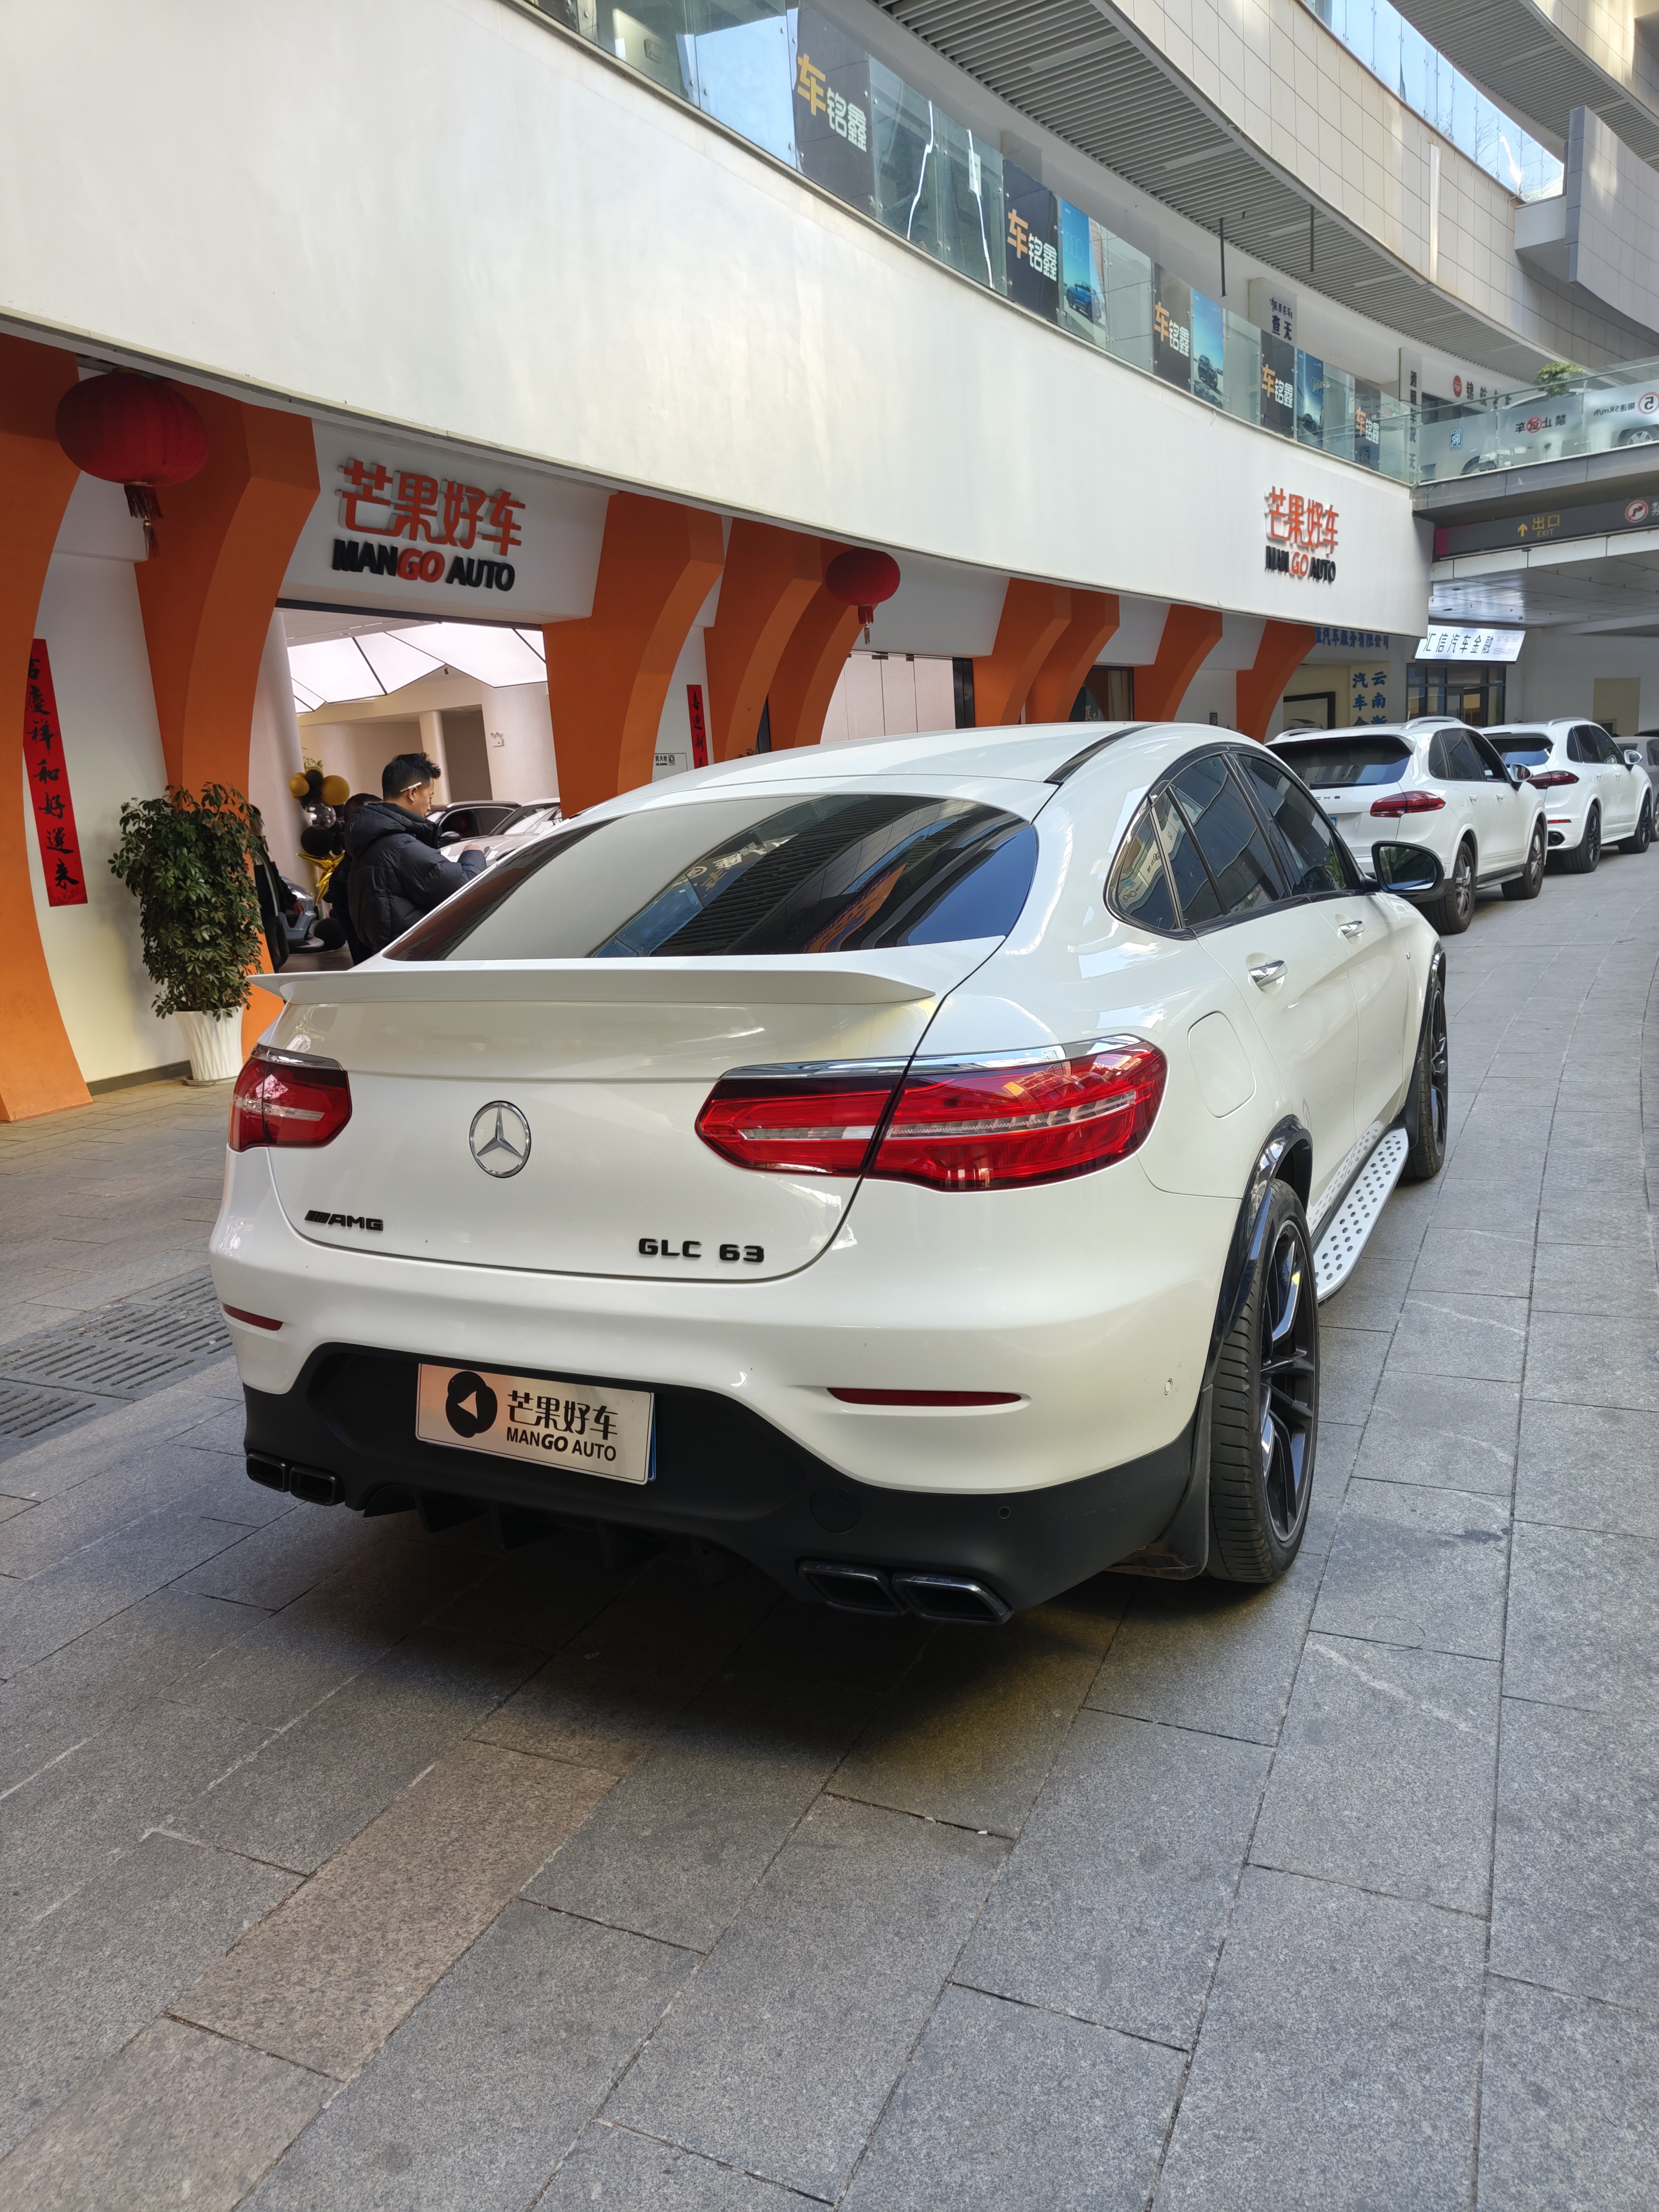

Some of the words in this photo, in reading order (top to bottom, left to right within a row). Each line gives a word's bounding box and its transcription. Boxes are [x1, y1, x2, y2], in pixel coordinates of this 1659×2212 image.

[337, 458, 526, 556] 芒果好车
[1266, 485, 1339, 555] 芒果好车
[1532, 515, 1560, 530] 出口
[1536, 529, 1554, 537] EXIT
[332, 538, 446, 583] MANGO
[446, 556, 515, 591] AUTO
[1265, 545, 1309, 577] MANGO
[1308, 557, 1336, 582] AUTO
[327, 1213, 383, 1231] AMG
[638, 1238, 702, 1258] GLC
[719, 1244, 765, 1263] 63
[507, 1390, 618, 1441] 芒果好车
[506, 1426, 569, 1453] MANGO
[571, 1439, 617, 1462] AUTO
